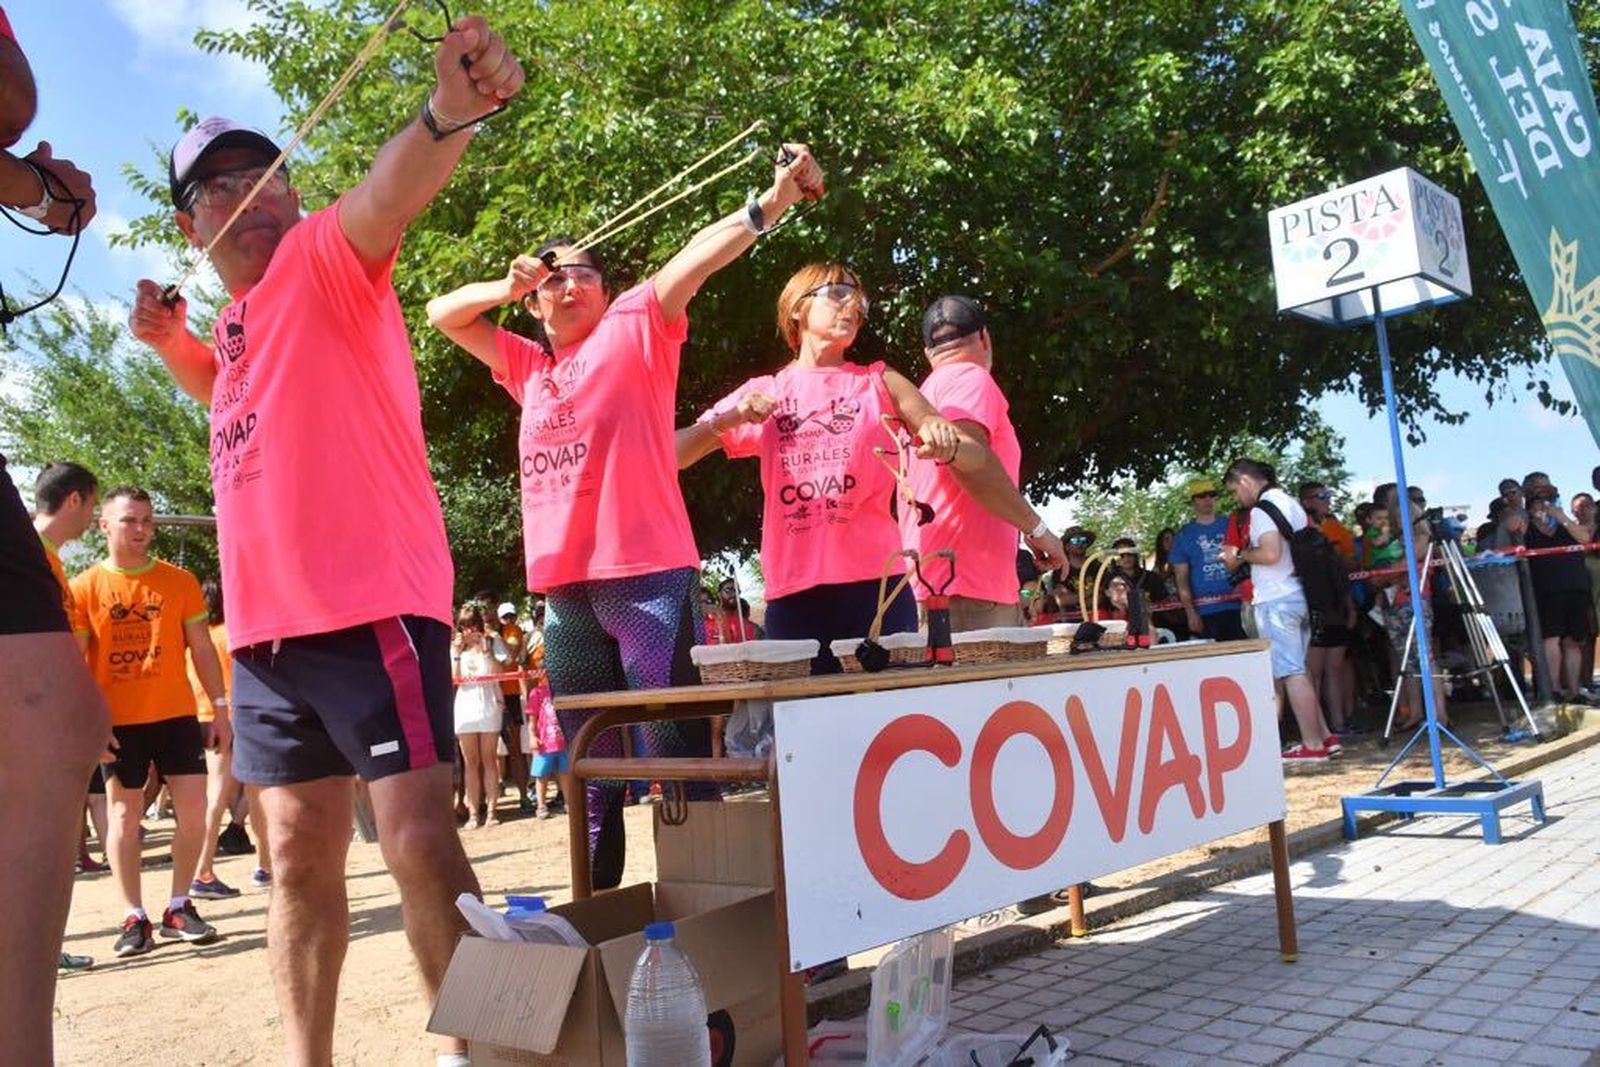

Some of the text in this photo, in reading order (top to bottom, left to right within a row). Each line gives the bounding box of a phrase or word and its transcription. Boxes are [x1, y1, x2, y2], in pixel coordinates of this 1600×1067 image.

[1280, 183, 1401, 245] PISTA
[1322, 237, 1366, 289] 2
[1434, 229, 1454, 279] 2
[210, 412, 258, 463] OVAP
[521, 442, 588, 478] COVAP
[781, 447, 851, 470] RURALES
[779, 474, 857, 506] COVAP
[853, 676, 1253, 902] COVAP
